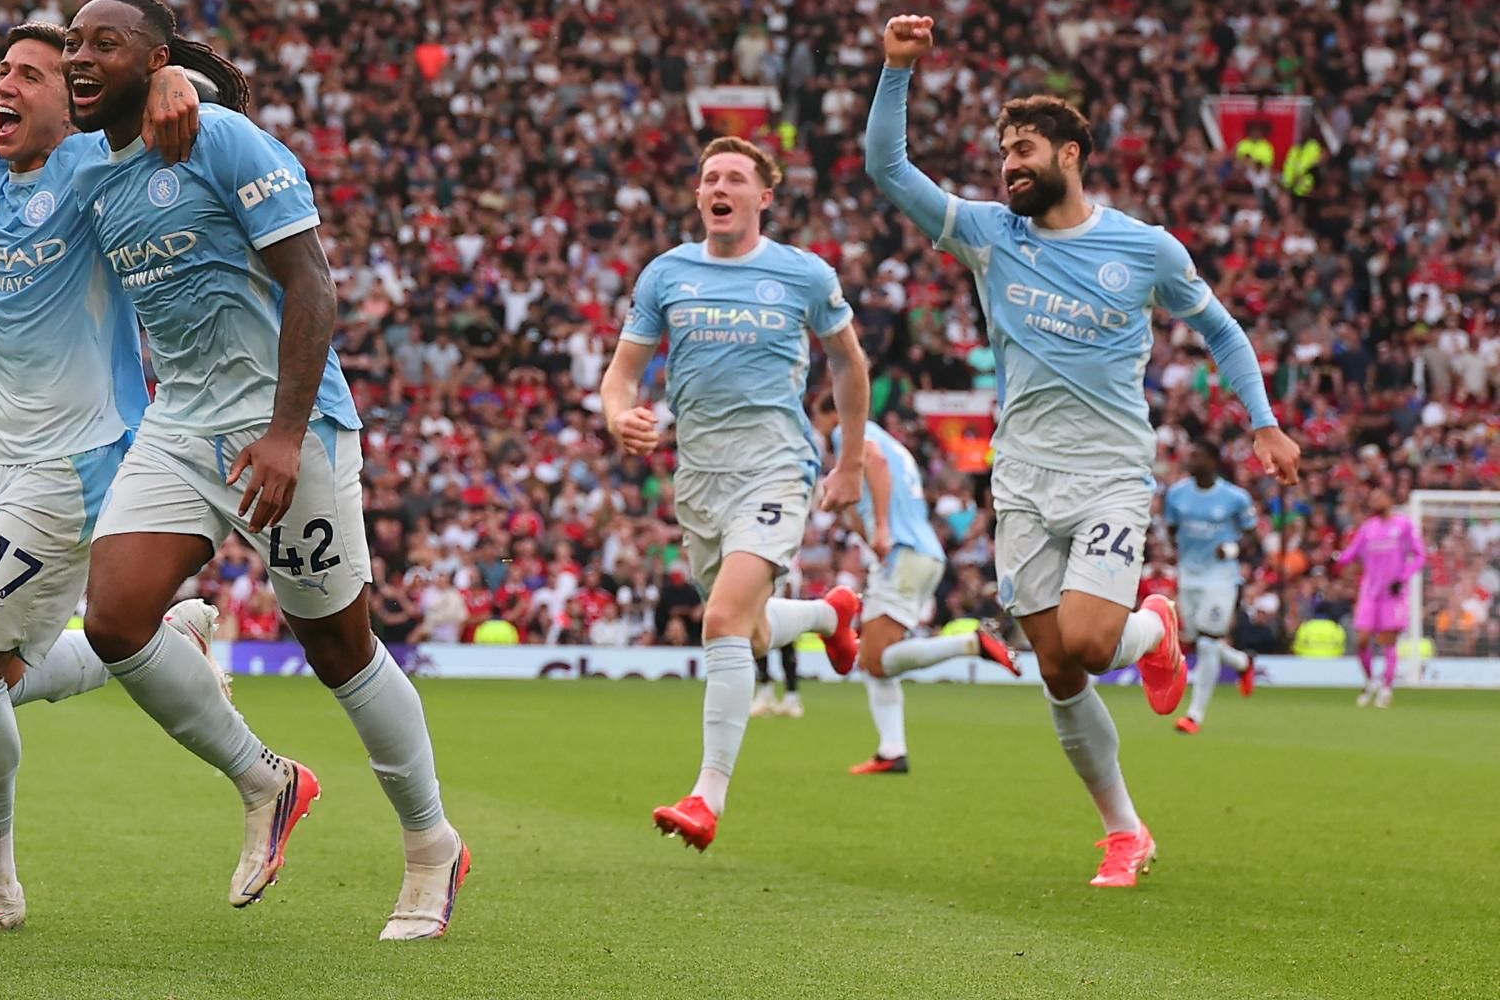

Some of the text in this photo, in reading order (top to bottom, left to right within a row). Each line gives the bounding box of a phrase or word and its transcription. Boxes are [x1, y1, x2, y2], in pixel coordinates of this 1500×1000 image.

[104, 230, 197, 273] TIHAD
[669, 307, 787, 329] ETIHAD
[1006, 283, 1128, 329] ETIHAD
[689, 330, 757, 344] AIRWAYS
[1024, 313, 1097, 341] AIRWAYS
[756, 502, 783, 526] 5
[269, 518, 341, 576] 42
[1085, 522, 1135, 567] 24
